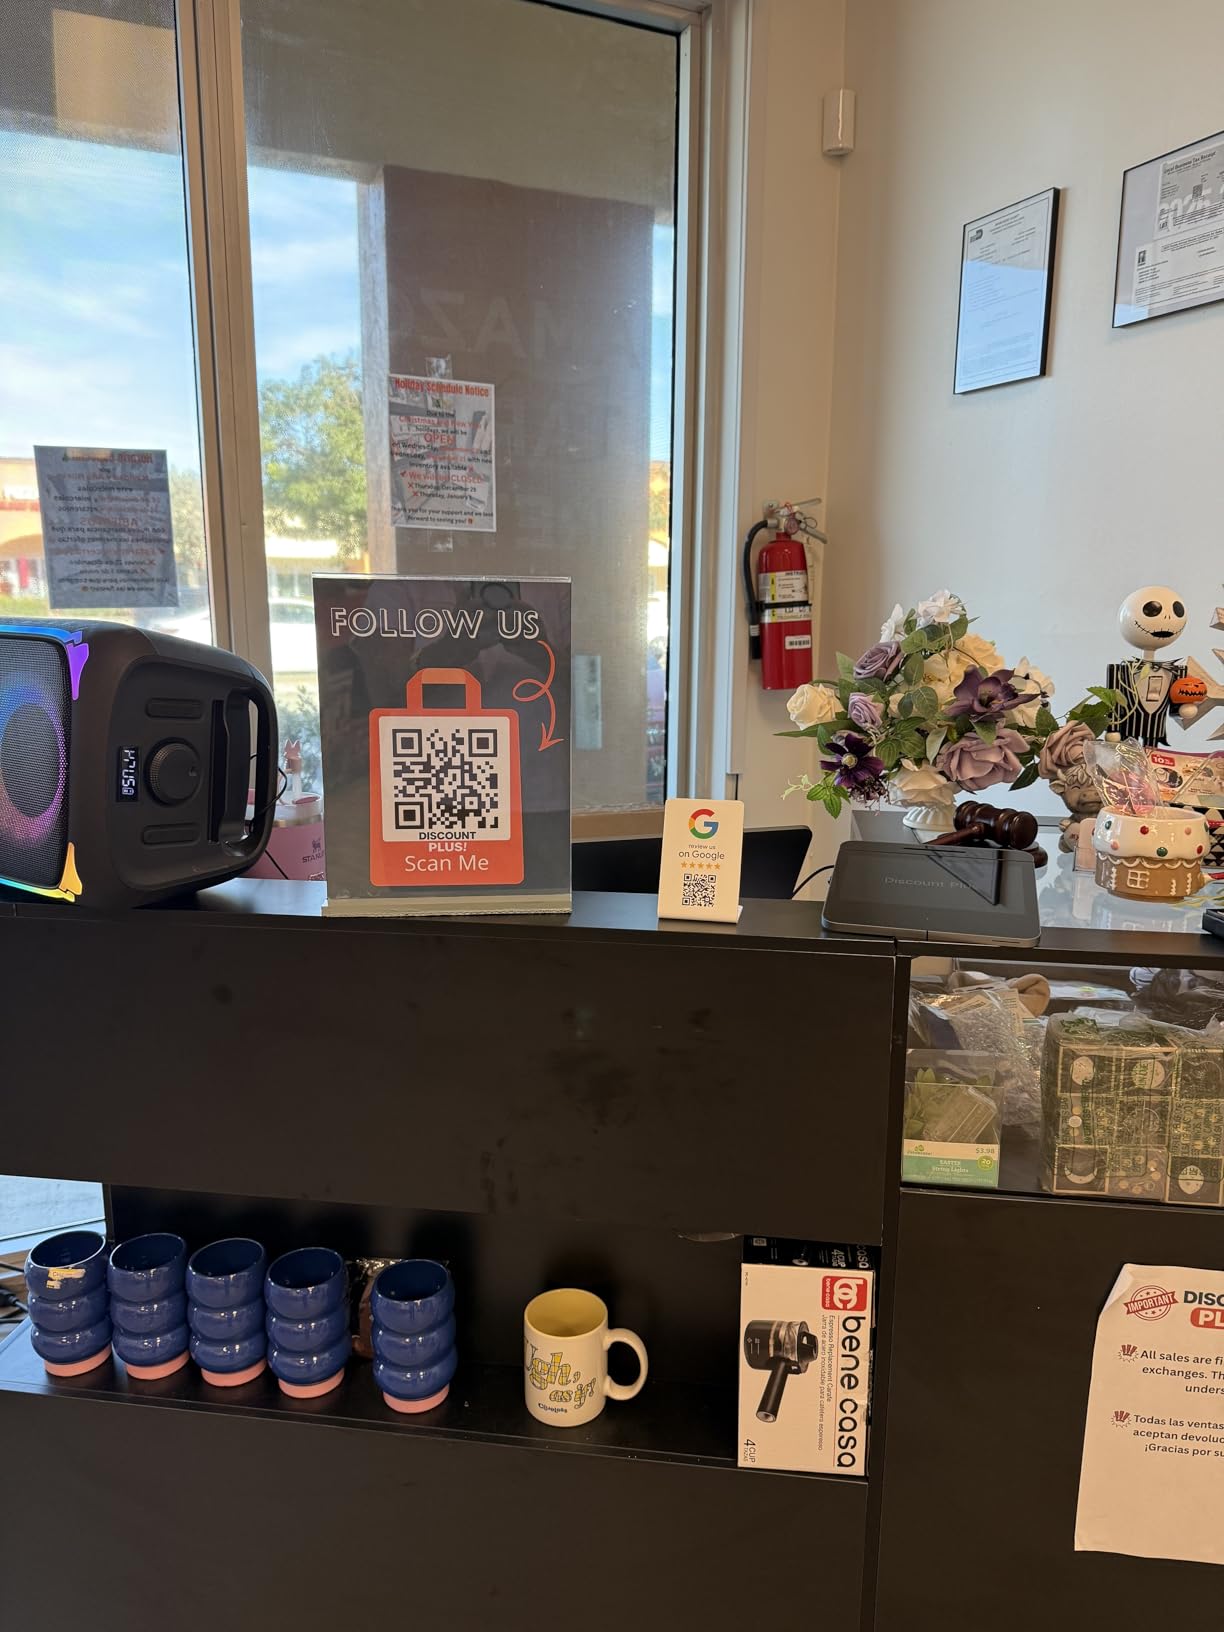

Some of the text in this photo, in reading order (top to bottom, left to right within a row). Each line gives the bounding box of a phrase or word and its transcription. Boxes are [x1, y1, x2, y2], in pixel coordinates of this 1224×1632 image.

[394, 378, 489, 397] Holiday Schedule Notice
[399, 416, 438, 426] Christmas
[424, 432, 455, 444] OPEN
[450, 474, 482, 484] CLOSED
[330, 608, 540, 640] FOLLOW US
[418, 830, 476, 840] DISCOUNT
[428, 842, 468, 852] PLUS!
[678, 850, 725, 861] on Google
[404, 854, 490, 872] Scan Me
[884, 876, 944, 888] Discount
[1128, 1293, 1175, 1313] IMPORTANT
[821, 1330, 828, 1338] de
[826, 1314, 836, 1402] Espresso Replacement Carafe
[1140, 1350, 1156, 1360] All
[1160, 1352, 1190, 1363] sales
[1192, 1356, 1212, 1365] are
[1142, 1366, 1208, 1380] exchanges.
[837, 1316, 866, 1468] bene casa
[1134, 1414, 1166, 1425] Todas
[1169, 1418, 1184, 1427] las
[1132, 1428, 1178, 1440] aceptan
[1144, 1443, 1190, 1455] ¡Gracias
[1192, 1448, 1211, 1457] por
